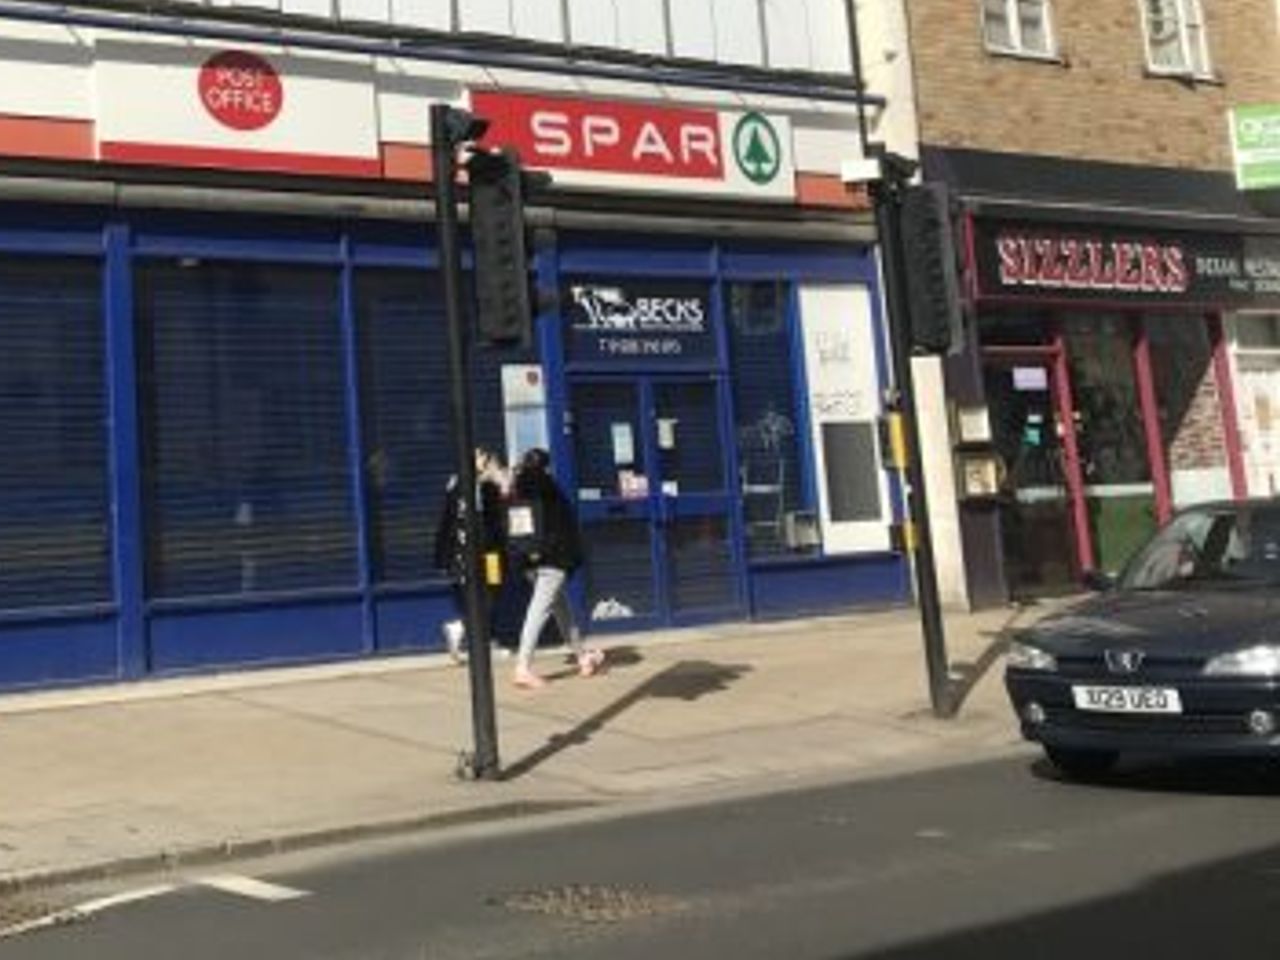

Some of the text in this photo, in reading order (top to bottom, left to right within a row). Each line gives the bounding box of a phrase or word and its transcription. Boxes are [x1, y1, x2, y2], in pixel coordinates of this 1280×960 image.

[205, 85, 275, 114] OFFICE
[214, 66, 263, 91] POST
[530, 111, 719, 166] SPAR
[997, 237, 1188, 292] SIZZLERS
